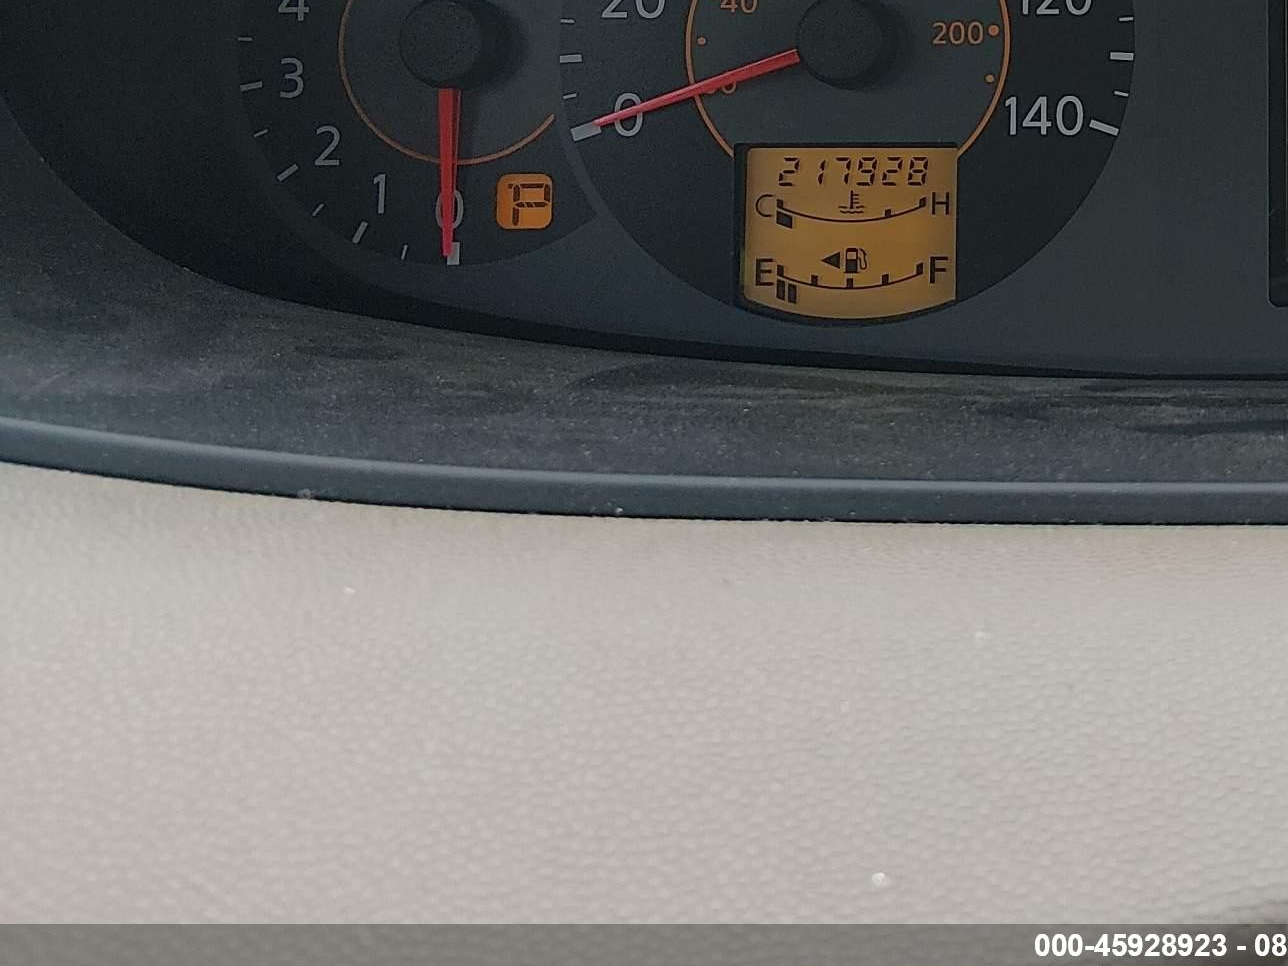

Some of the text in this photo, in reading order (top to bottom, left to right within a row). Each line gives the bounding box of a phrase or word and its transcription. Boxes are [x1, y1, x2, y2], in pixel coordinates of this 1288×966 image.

[932, 22, 984, 44] 200
[279, 58, 304, 98] 3
[614, 93, 643, 136] 0
[1004, 95, 1084, 136] 140
[315, 126, 340, 166] 2
[778, 156, 929, 187] 217928
[372, 174, 385, 213] 1
[507, 183, 550, 226] P
[755, 194, 774, 217] C
[931, 192, 950, 215] H
[755, 258, 774, 286] E
[929, 256, 949, 284] F
